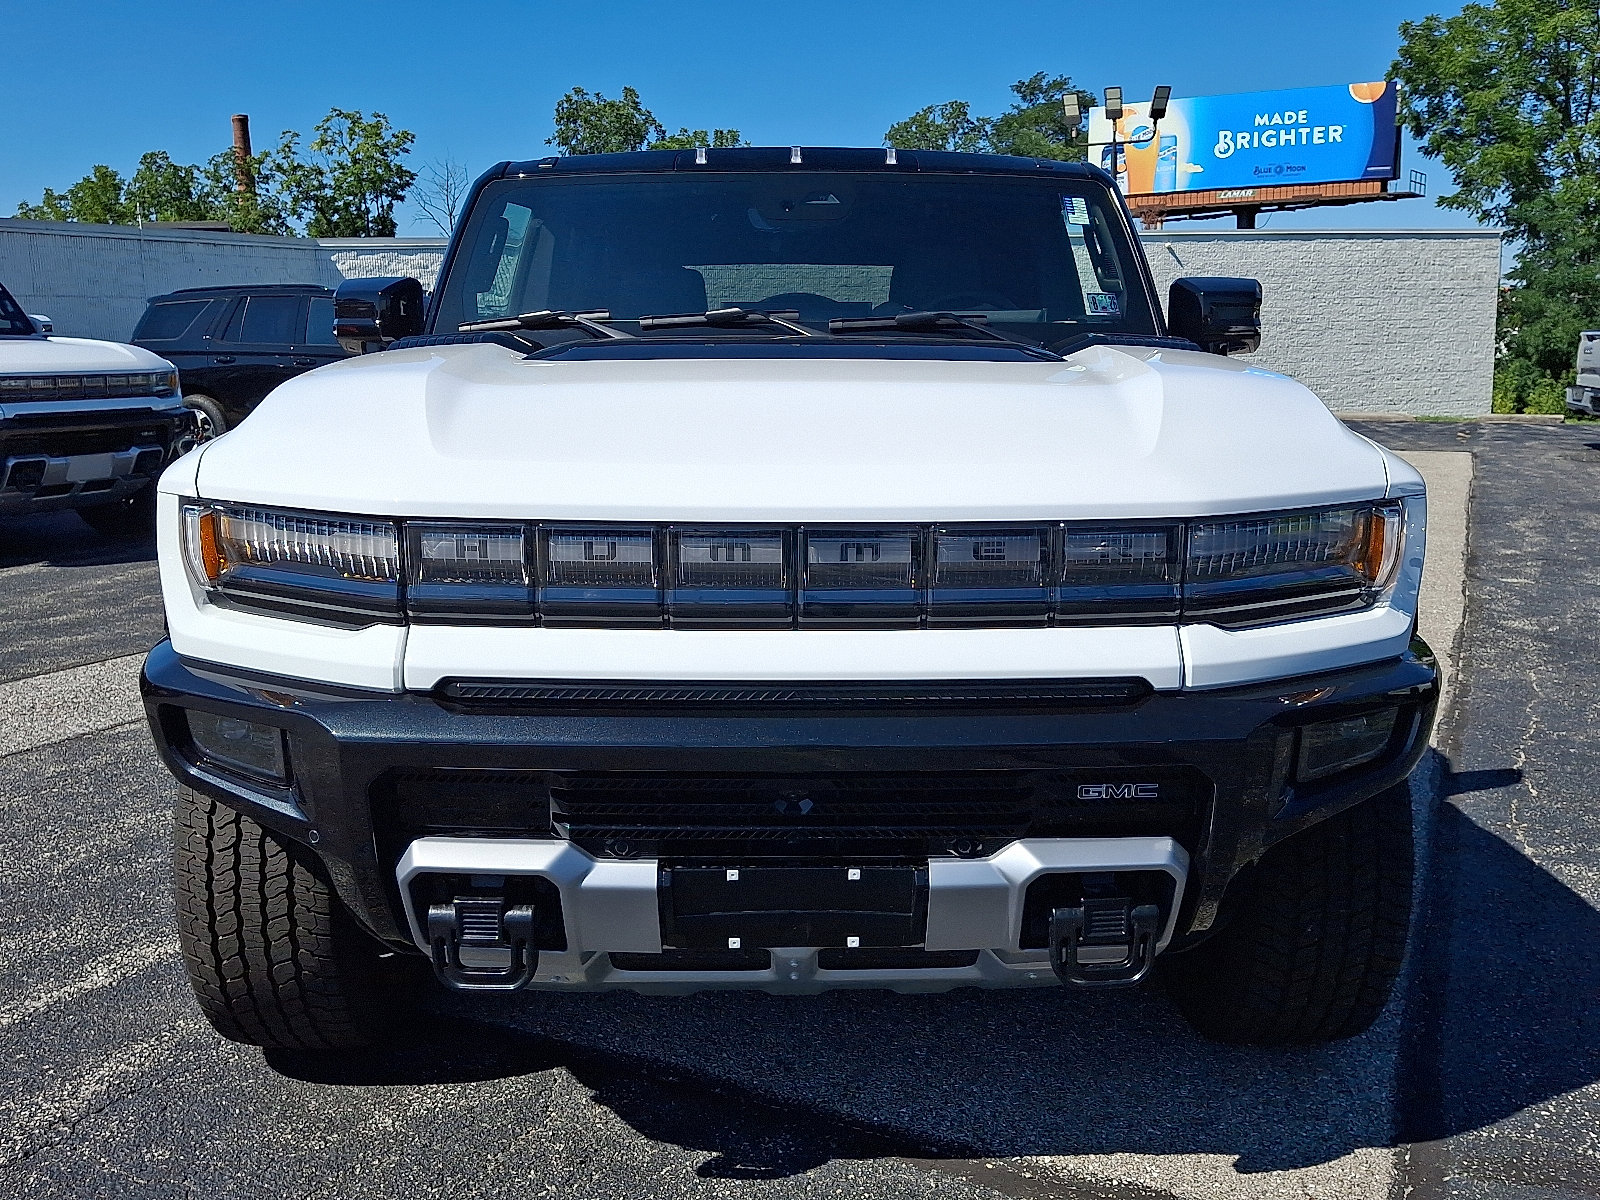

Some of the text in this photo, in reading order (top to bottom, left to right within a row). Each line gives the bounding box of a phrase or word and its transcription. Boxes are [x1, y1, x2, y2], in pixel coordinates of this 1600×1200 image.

[1254, 110, 1308, 127] MADE
[1213, 125, 1343, 159] BRIGHTER
[1253, 166, 1272, 175] BLUE
[1220, 189, 1253, 198] LAMAR
[1077, 783, 1159, 800] GMC
